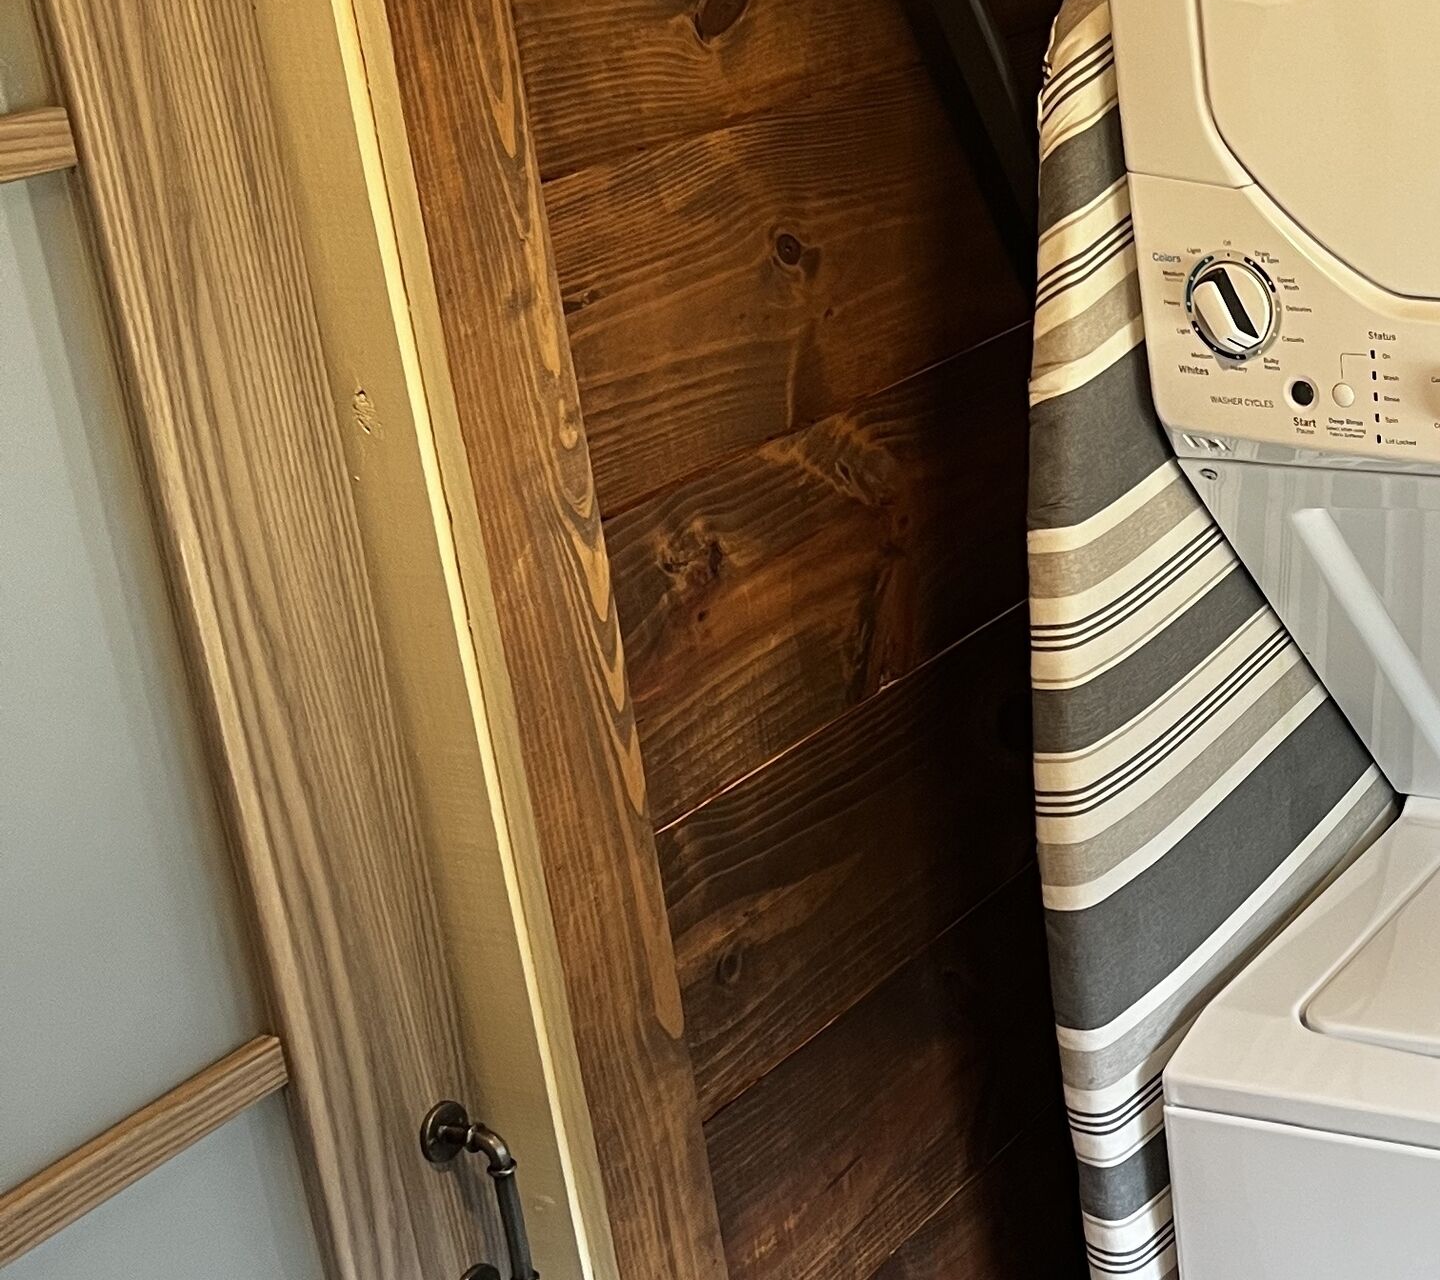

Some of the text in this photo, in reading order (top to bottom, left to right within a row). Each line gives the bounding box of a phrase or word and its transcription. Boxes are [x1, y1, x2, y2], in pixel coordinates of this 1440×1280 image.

[1152, 252, 1182, 264] Colors
[1367, 331, 1397, 341] Status
[1178, 364, 1210, 376] Whites
[1209, 395, 1275, 409] WASHER CYCLES
[1293, 416, 1317, 428] Start
